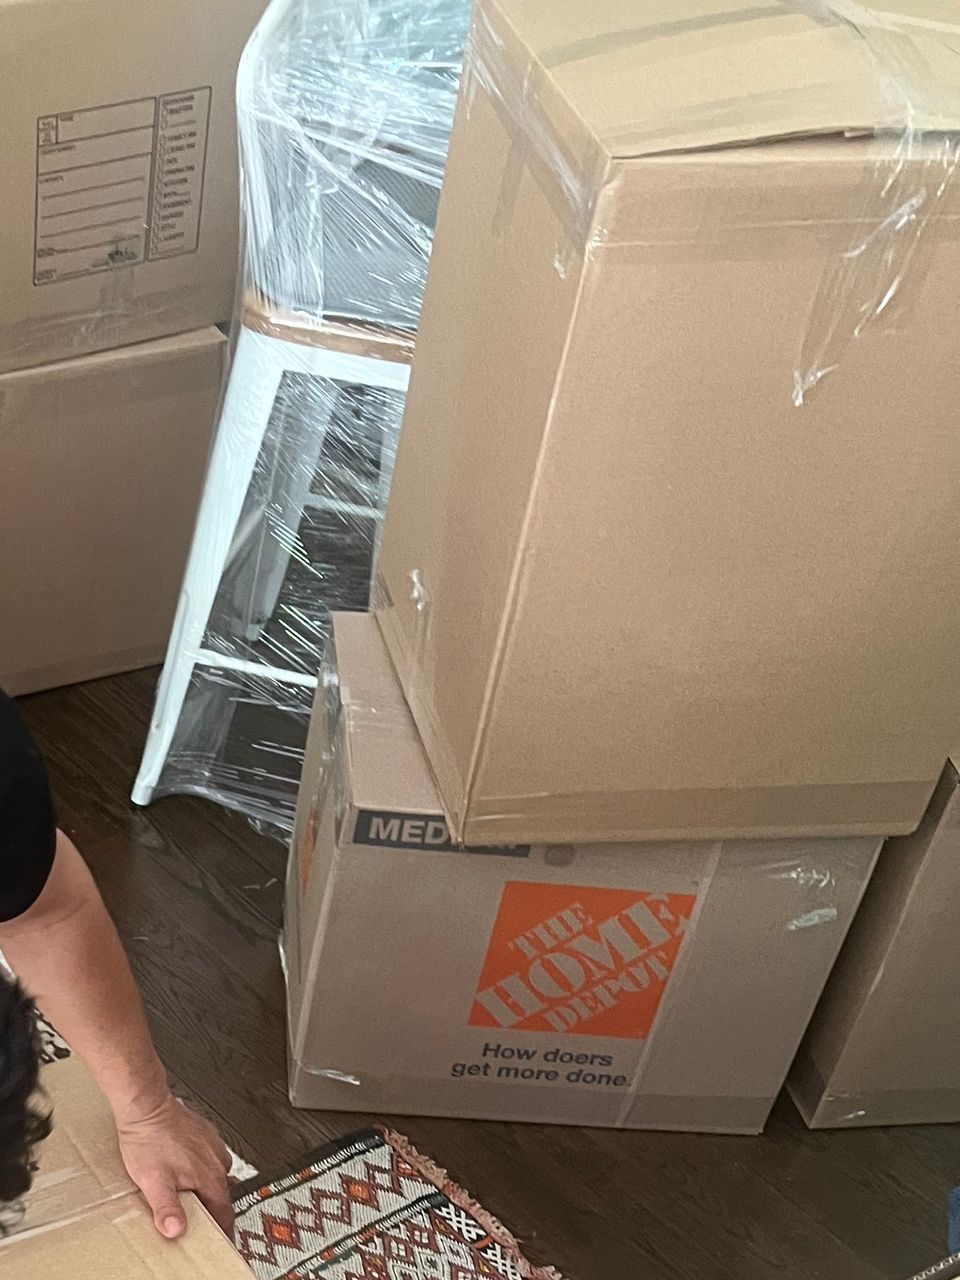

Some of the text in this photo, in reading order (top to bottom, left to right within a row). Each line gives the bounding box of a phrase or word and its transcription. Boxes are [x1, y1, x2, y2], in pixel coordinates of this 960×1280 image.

[507, 901, 592, 958] THE
[476, 892, 690, 1029] HOME
[544, 950, 670, 1033] DEPOT
[450, 1060, 633, 1088] get more done.
[482, 1043, 614, 1067] How doers
